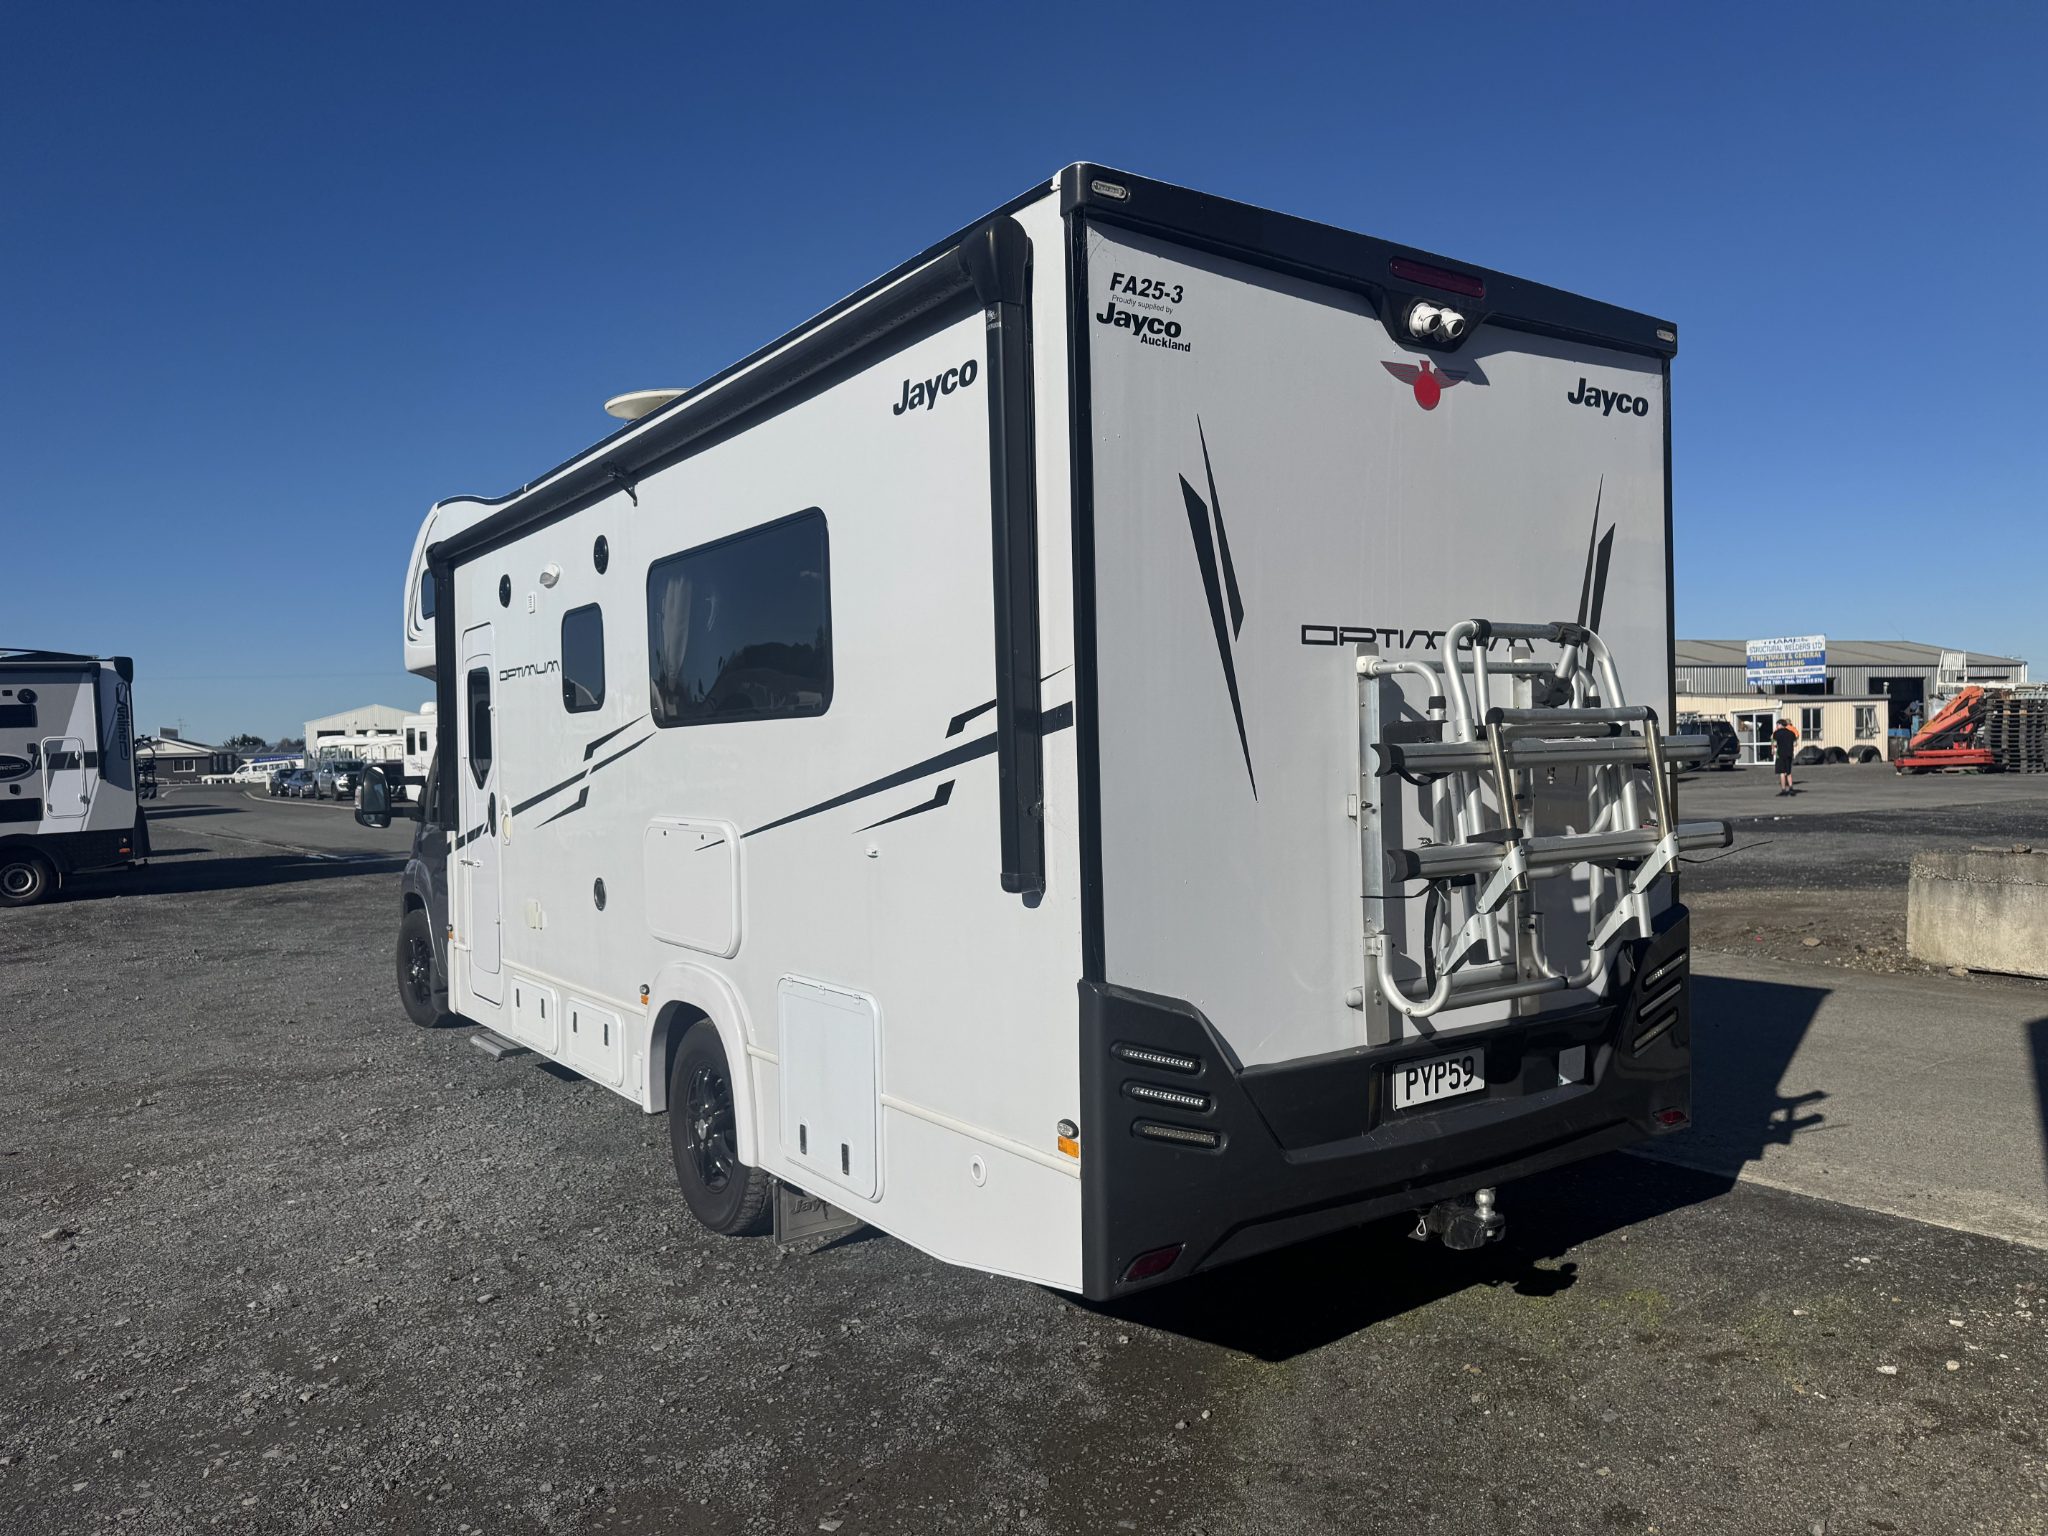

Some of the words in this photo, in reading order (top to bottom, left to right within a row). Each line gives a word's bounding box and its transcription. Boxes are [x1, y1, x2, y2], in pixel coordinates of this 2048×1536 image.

[1110, 272, 1184, 304] FA25-3
[1096, 302, 1182, 338] Jayco
[1112, 294, 1136, 307] Proudly
[1138, 301, 1165, 313] supplied
[1165, 306, 1174, 315] by
[1140, 333, 1192, 353] Auckland
[892, 359, 978, 416] Jayco
[1567, 377, 1649, 417] Jayco
[1301, 624, 1535, 653] OPTIMM
[499, 660, 561, 681] OPTIMUM
[1405, 1055, 1475, 1101] PYP59
